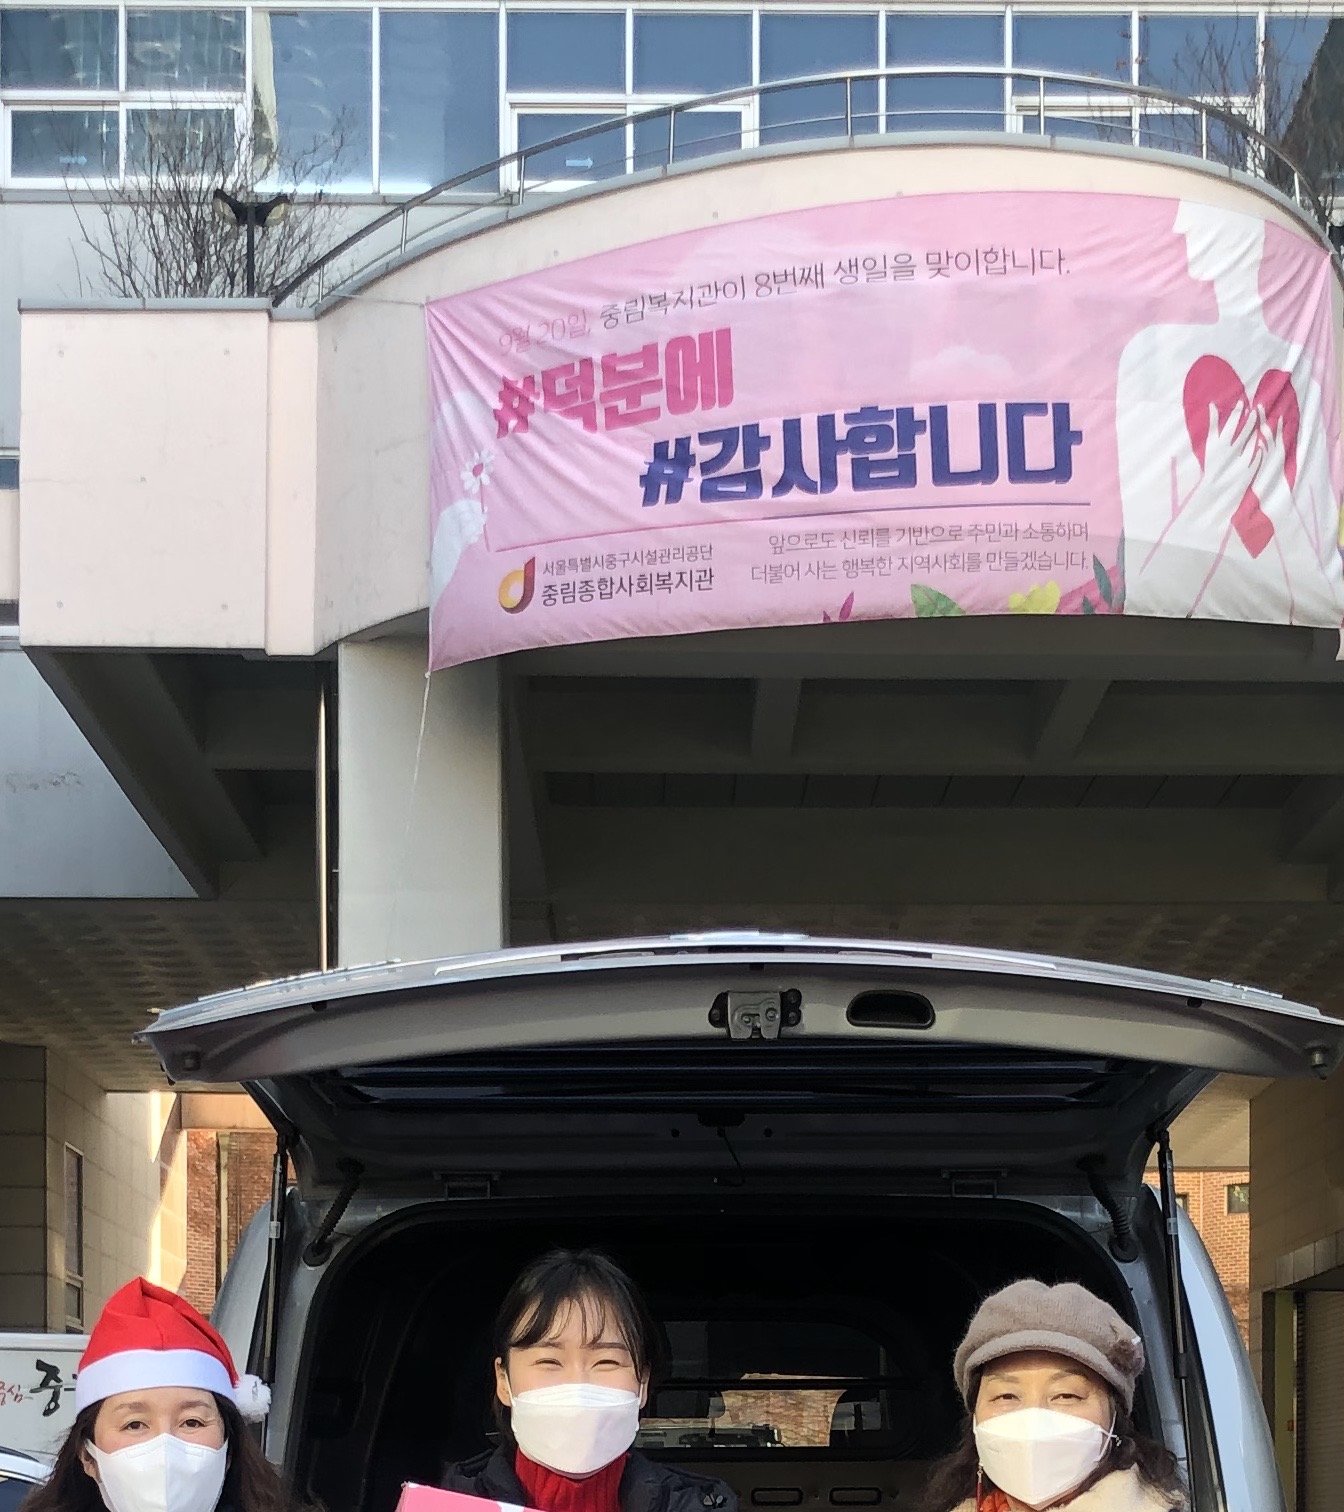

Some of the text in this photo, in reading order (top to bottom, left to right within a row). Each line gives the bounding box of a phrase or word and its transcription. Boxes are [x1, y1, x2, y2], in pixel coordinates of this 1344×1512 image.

[600, 275, 746, 330] 중림복지관이
[755, 263, 825, 298] 8번째
[834, 253, 917, 285] 생일을
[926, 247, 1071, 278] 맞이합니다.
[493, 327, 734, 439] #덕분에
[639, 402, 1084, 507] #감사합니다
[543, 543, 713, 576] 서울특별시중구시설관리공단
[768, 521, 1090, 555] 앞으로도 신뢰를 기반으로 주민과 소통하며
[541, 567, 715, 607] 중림종합사회복지관
[751, 551, 1089, 584] 더불어 사는 행복한 지역사회를 만들겠습니다.
[29, 1358, 77, 1417] 중
